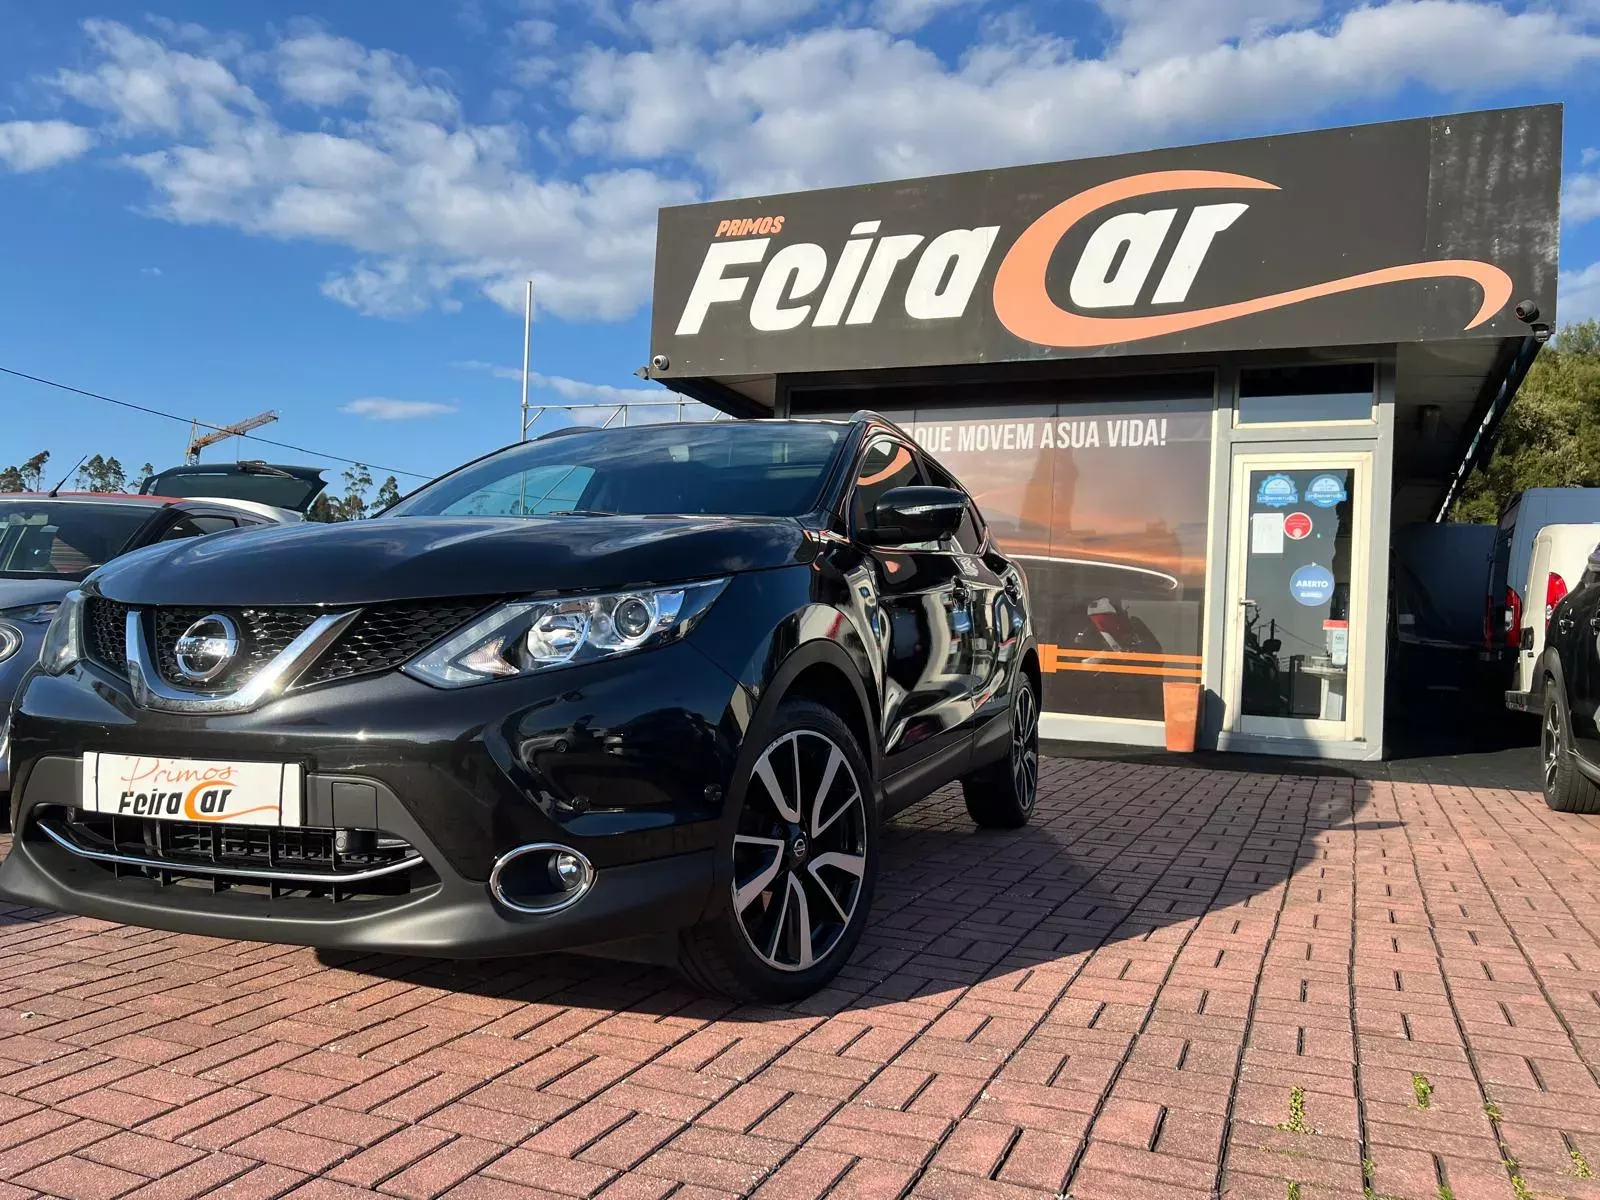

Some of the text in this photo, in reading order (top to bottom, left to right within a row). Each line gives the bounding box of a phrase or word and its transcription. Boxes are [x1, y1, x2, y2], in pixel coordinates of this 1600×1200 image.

[715, 215, 785, 238] PRIMOS
[914, 426, 953, 453] QUE
[958, 423, 1035, 452] MOVEM
[1107, 418, 1168, 448] VIDA!
[1295, 580, 1329, 588] ABERTO
[120, 757, 238, 795] Primos
